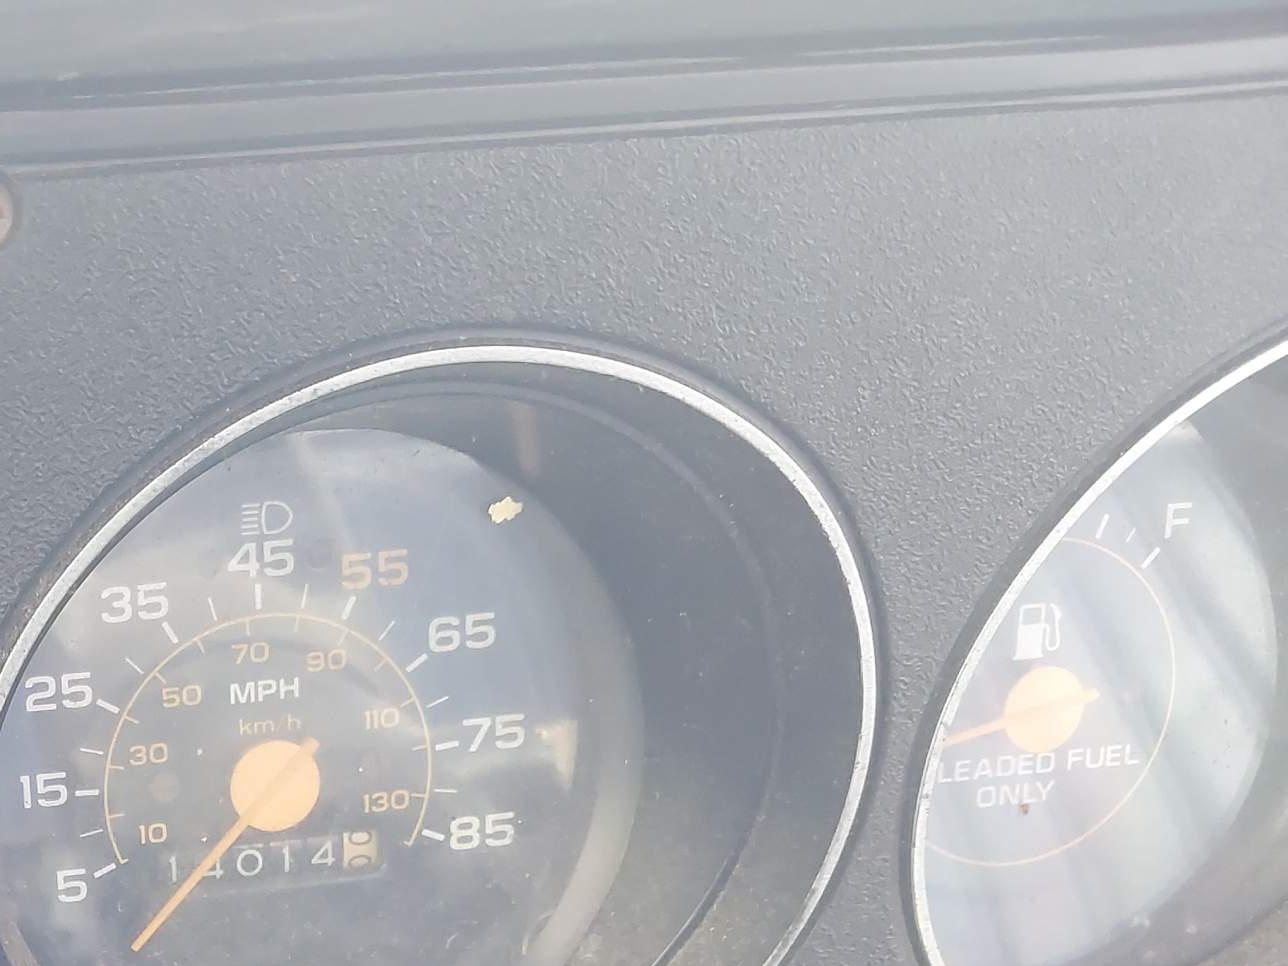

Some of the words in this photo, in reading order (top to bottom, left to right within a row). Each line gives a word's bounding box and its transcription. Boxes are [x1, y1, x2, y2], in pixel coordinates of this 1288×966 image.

[1164, 502, 1193, 539] F
[227, 539, 295, 578] 45
[340, 549, 410, 589] 55
[100, 582, 170, 624] 35
[428, 613, 497, 652] 65
[231, 643, 270, 664] 70
[306, 649, 348, 673] 90
[24, 672, 93, 712] 25
[161, 685, 202, 707] 50
[229, 677, 301, 705] MPH
[238, 713, 301, 736] km/h
[364, 707, 401, 730] 110
[462, 714, 526, 752] 75
[128, 743, 169, 765] 30
[1066, 744, 1141, 771] FUEL
[19, 771, 68, 808] 15
[362, 790, 410, 813] 130
[975, 779, 1055, 808] ONLY
[138, 823, 168, 844] 10
[448, 812, 516, 851] 85
[56, 868, 88, 903] 5
